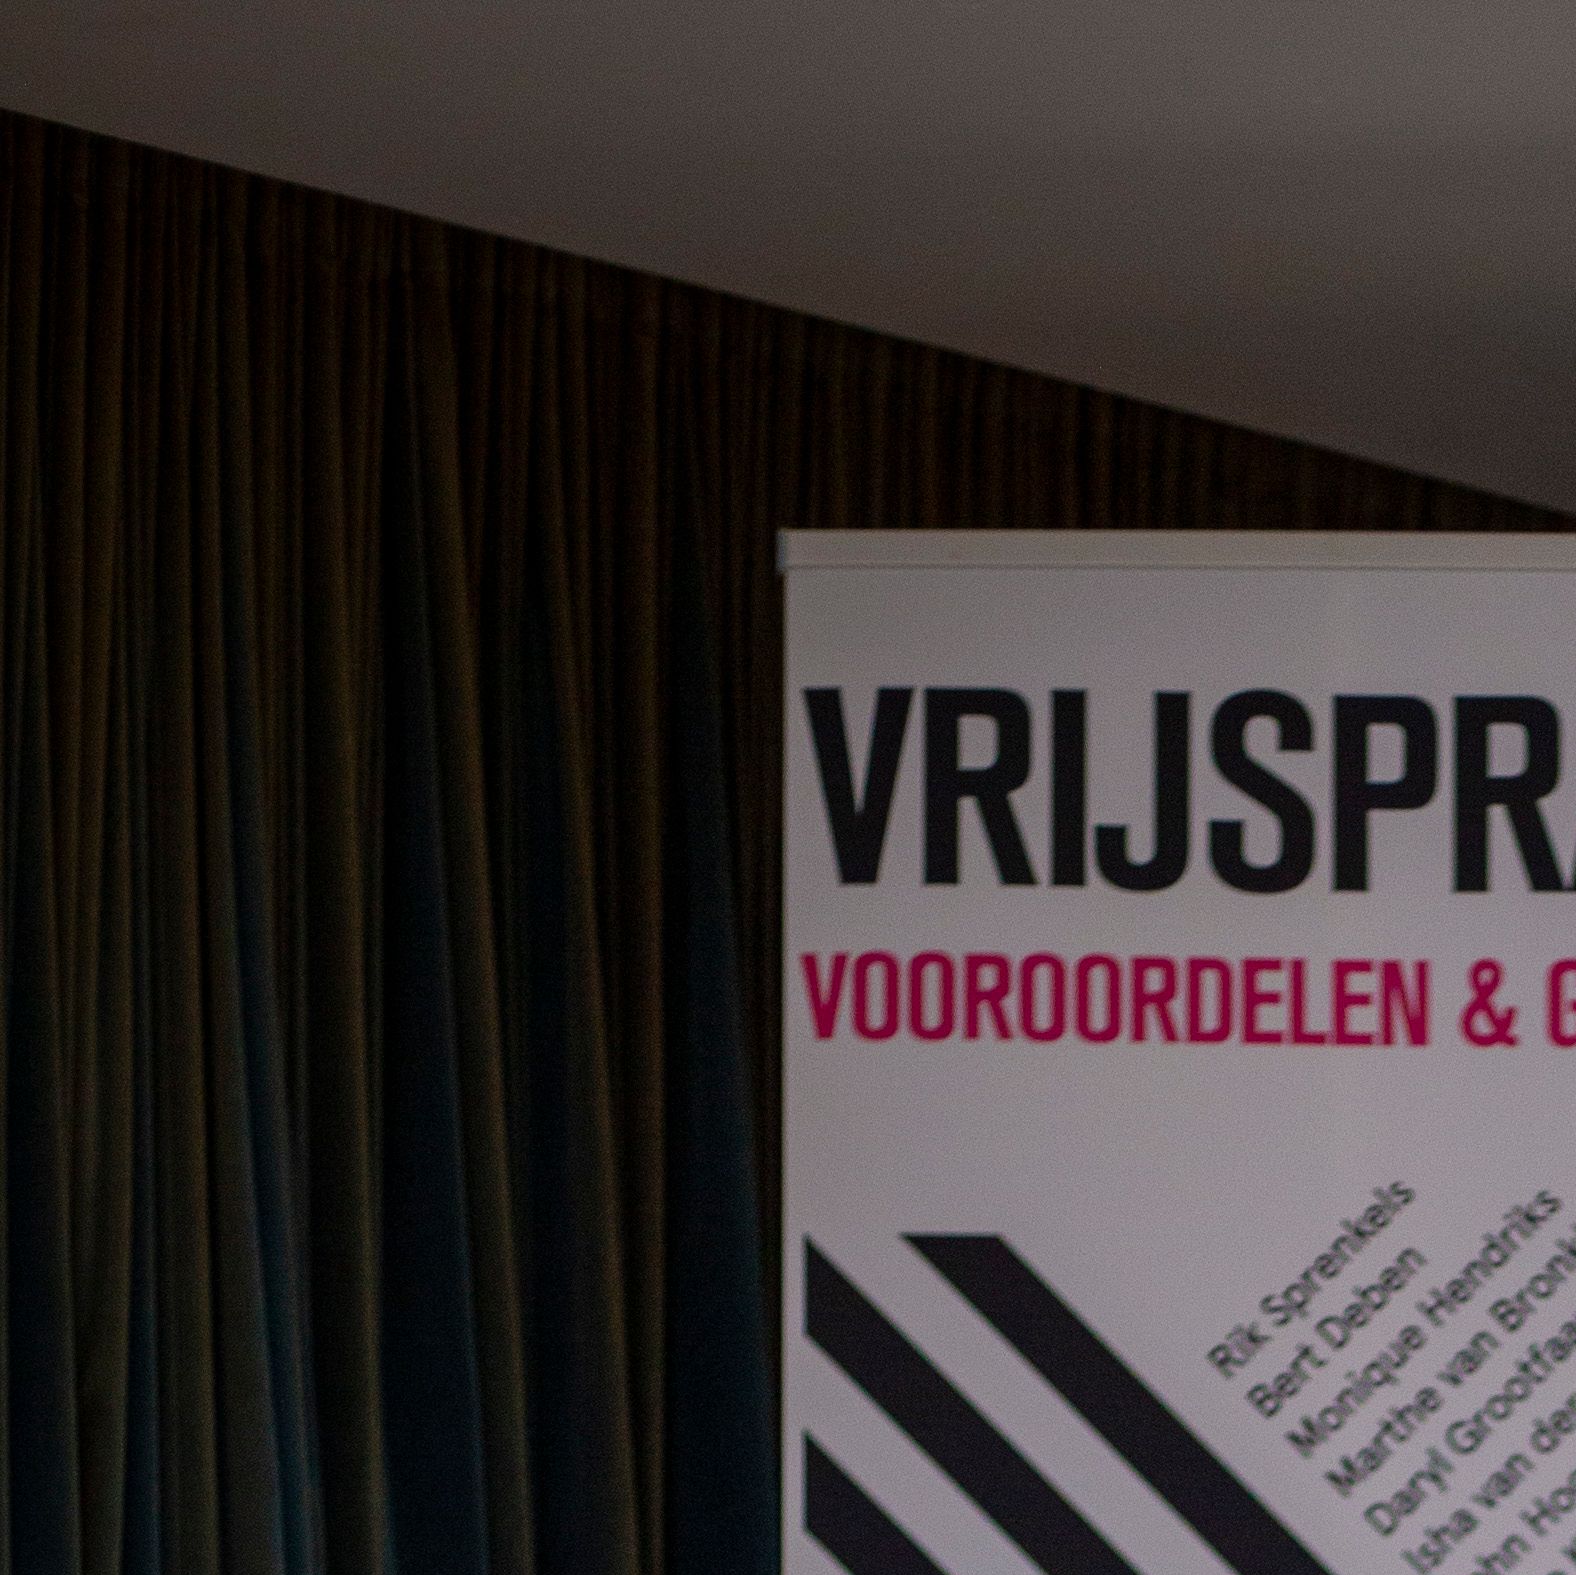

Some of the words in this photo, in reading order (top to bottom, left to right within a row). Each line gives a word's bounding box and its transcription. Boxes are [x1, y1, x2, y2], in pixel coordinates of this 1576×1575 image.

[800, 950, 1429, 1048] VOOROORDELEN
[1460, 959, 1519, 1048] &
[1208, 1325, 1268, 1376] Rik
[1247, 1346, 1324, 1416] Bert
[1316, 1249, 1424, 1348] Deben
[1285, 1326, 1424, 1456] Monique
[1418, 1192, 1560, 1324] Hendriks
[1325, 1388, 1440, 1495] Marthe
[1438, 1332, 1498, 1385] van
[1364, 1449, 1452, 1535] Daryl
[1403, 1510, 1477, 1574] Isha
[1473, 1454, 1532, 1507] van
